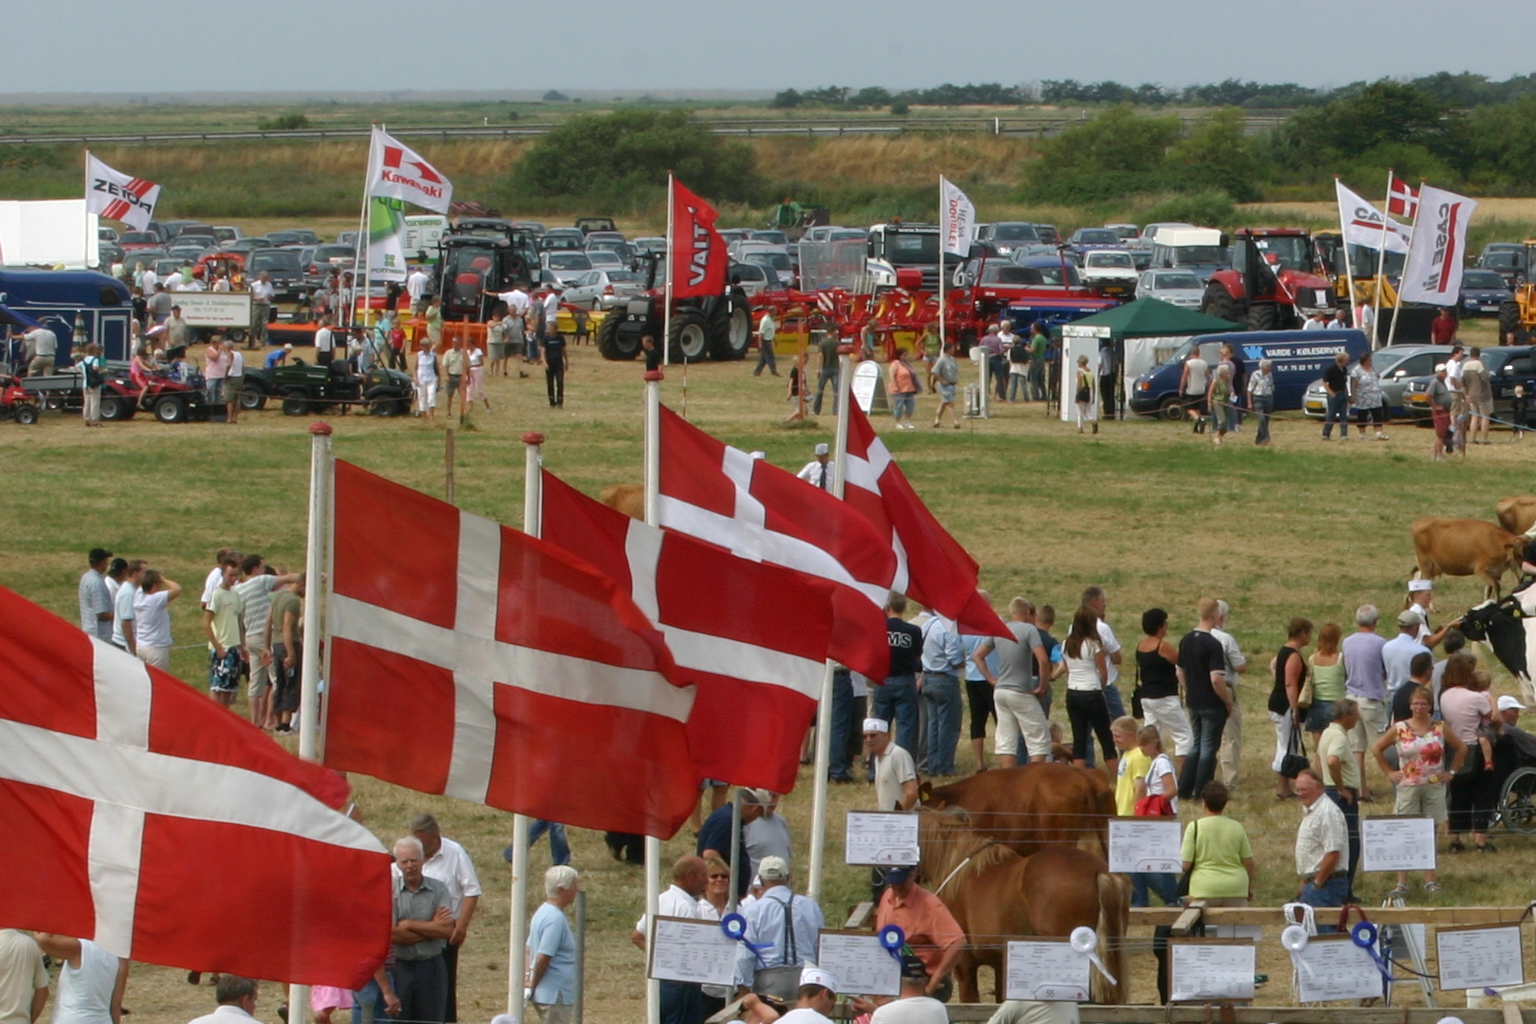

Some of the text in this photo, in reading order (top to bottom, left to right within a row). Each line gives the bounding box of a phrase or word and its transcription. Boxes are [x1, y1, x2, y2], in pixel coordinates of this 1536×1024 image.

[93, 178, 152, 215] ZETOR
[381, 170, 443, 199] Kawasaki
[1432, 202, 1450, 267] CASE
[1265, 346, 1346, 357] VARDE KØLESERVICE
